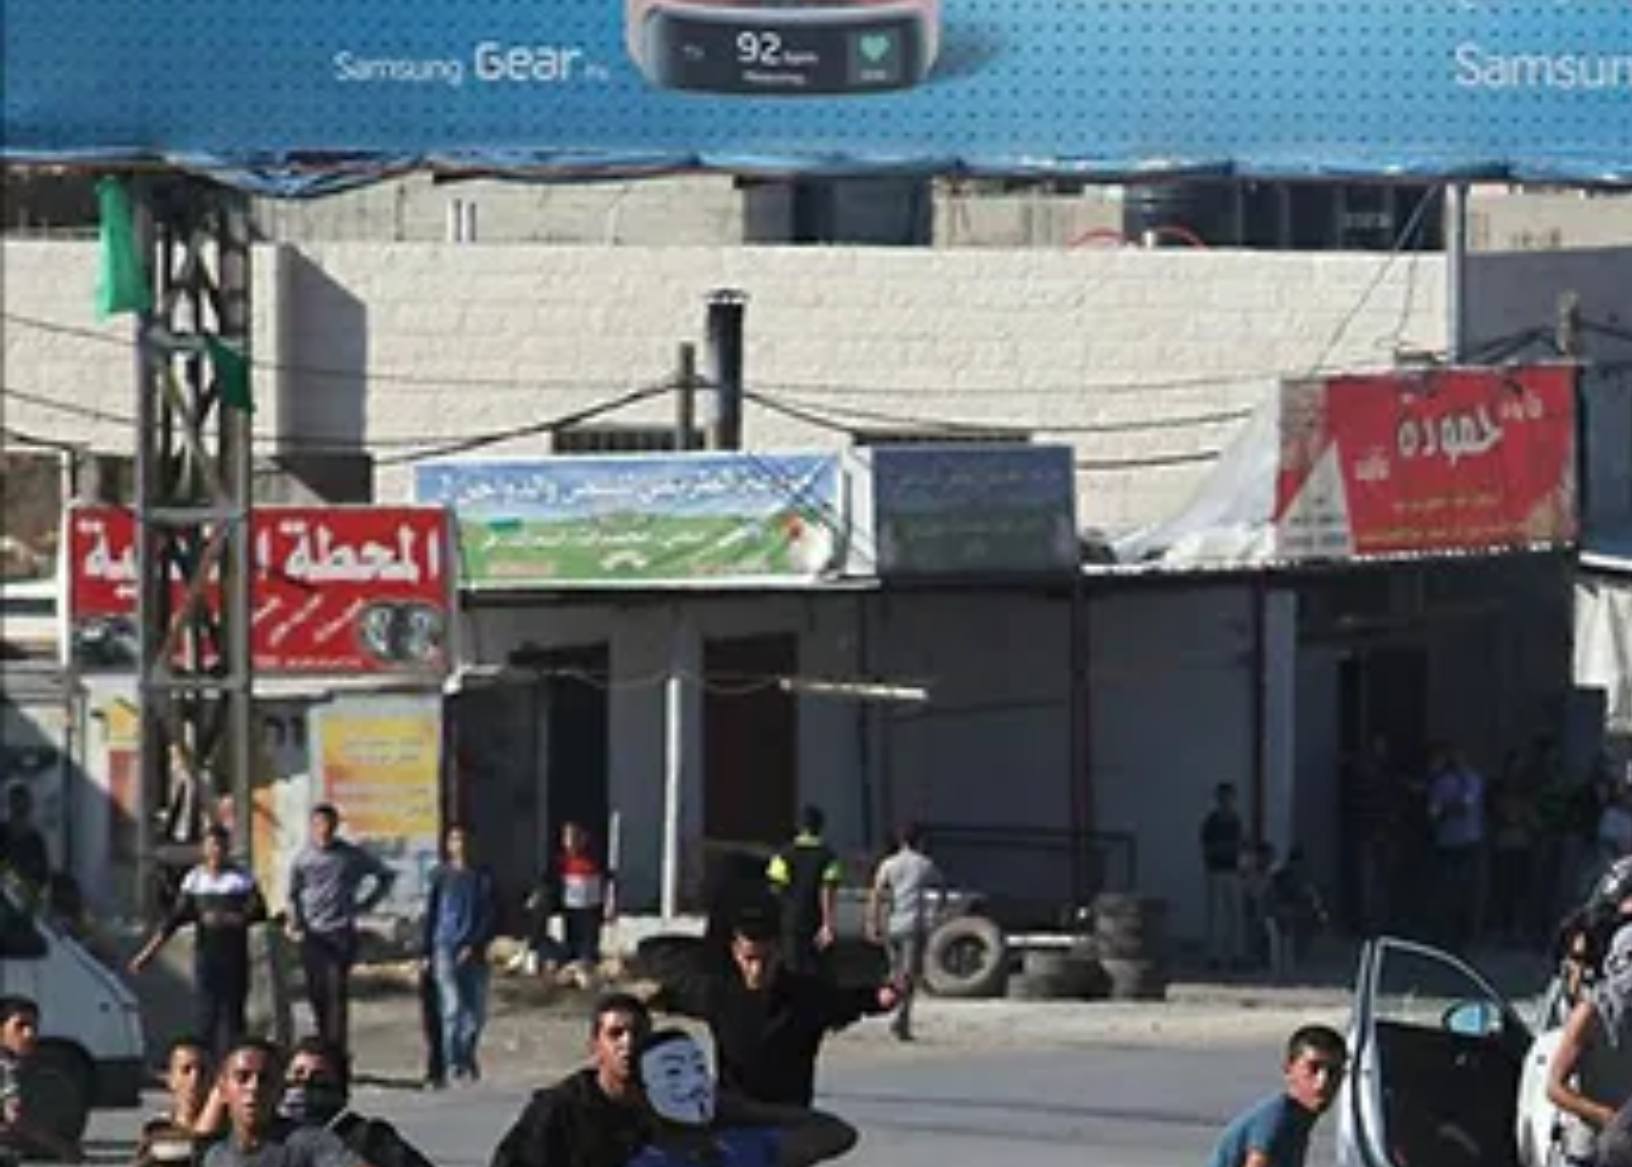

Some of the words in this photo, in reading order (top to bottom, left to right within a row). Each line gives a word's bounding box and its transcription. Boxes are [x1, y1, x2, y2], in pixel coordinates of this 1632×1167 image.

[333, 50, 464, 86] Samsung
[474, 39, 583, 82] Gear
[736, 31, 782, 66] 92
[279, 518, 439, 584] المحطة
